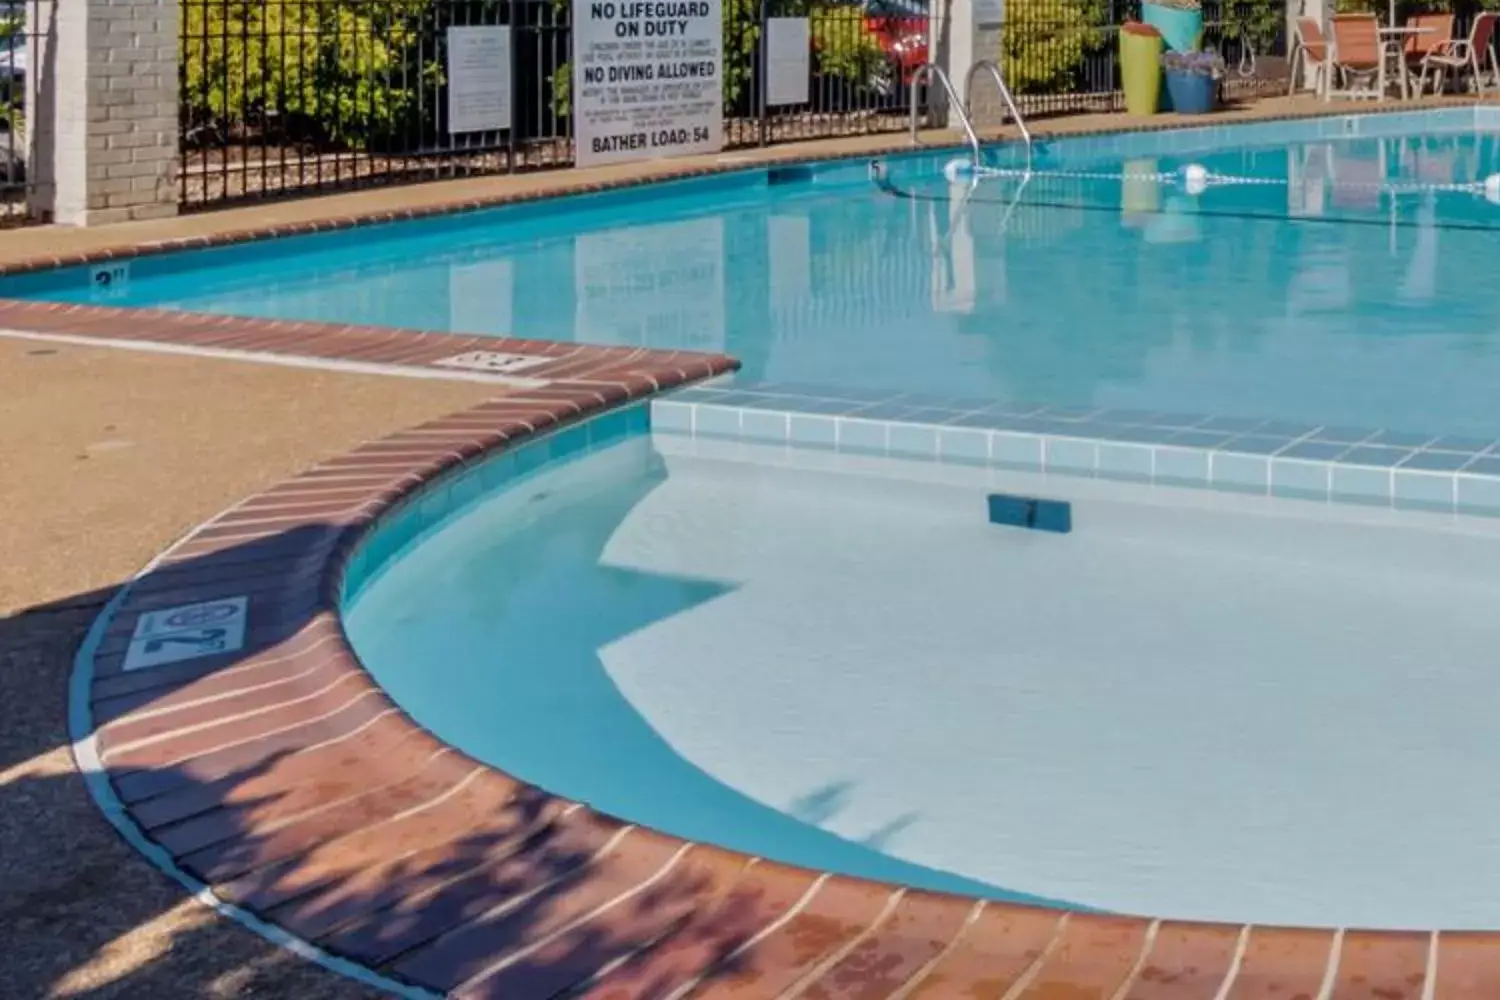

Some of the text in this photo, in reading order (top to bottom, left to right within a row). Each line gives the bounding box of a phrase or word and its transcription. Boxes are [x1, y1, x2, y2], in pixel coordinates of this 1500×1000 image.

[591, 1, 709, 19] NO LIFEGUARD
[615, 20, 688, 37] ON DUTY
[585, 61, 715, 83] NO DIVING ALLOWED
[592, 127, 709, 153] BATHER LOAD: 54
